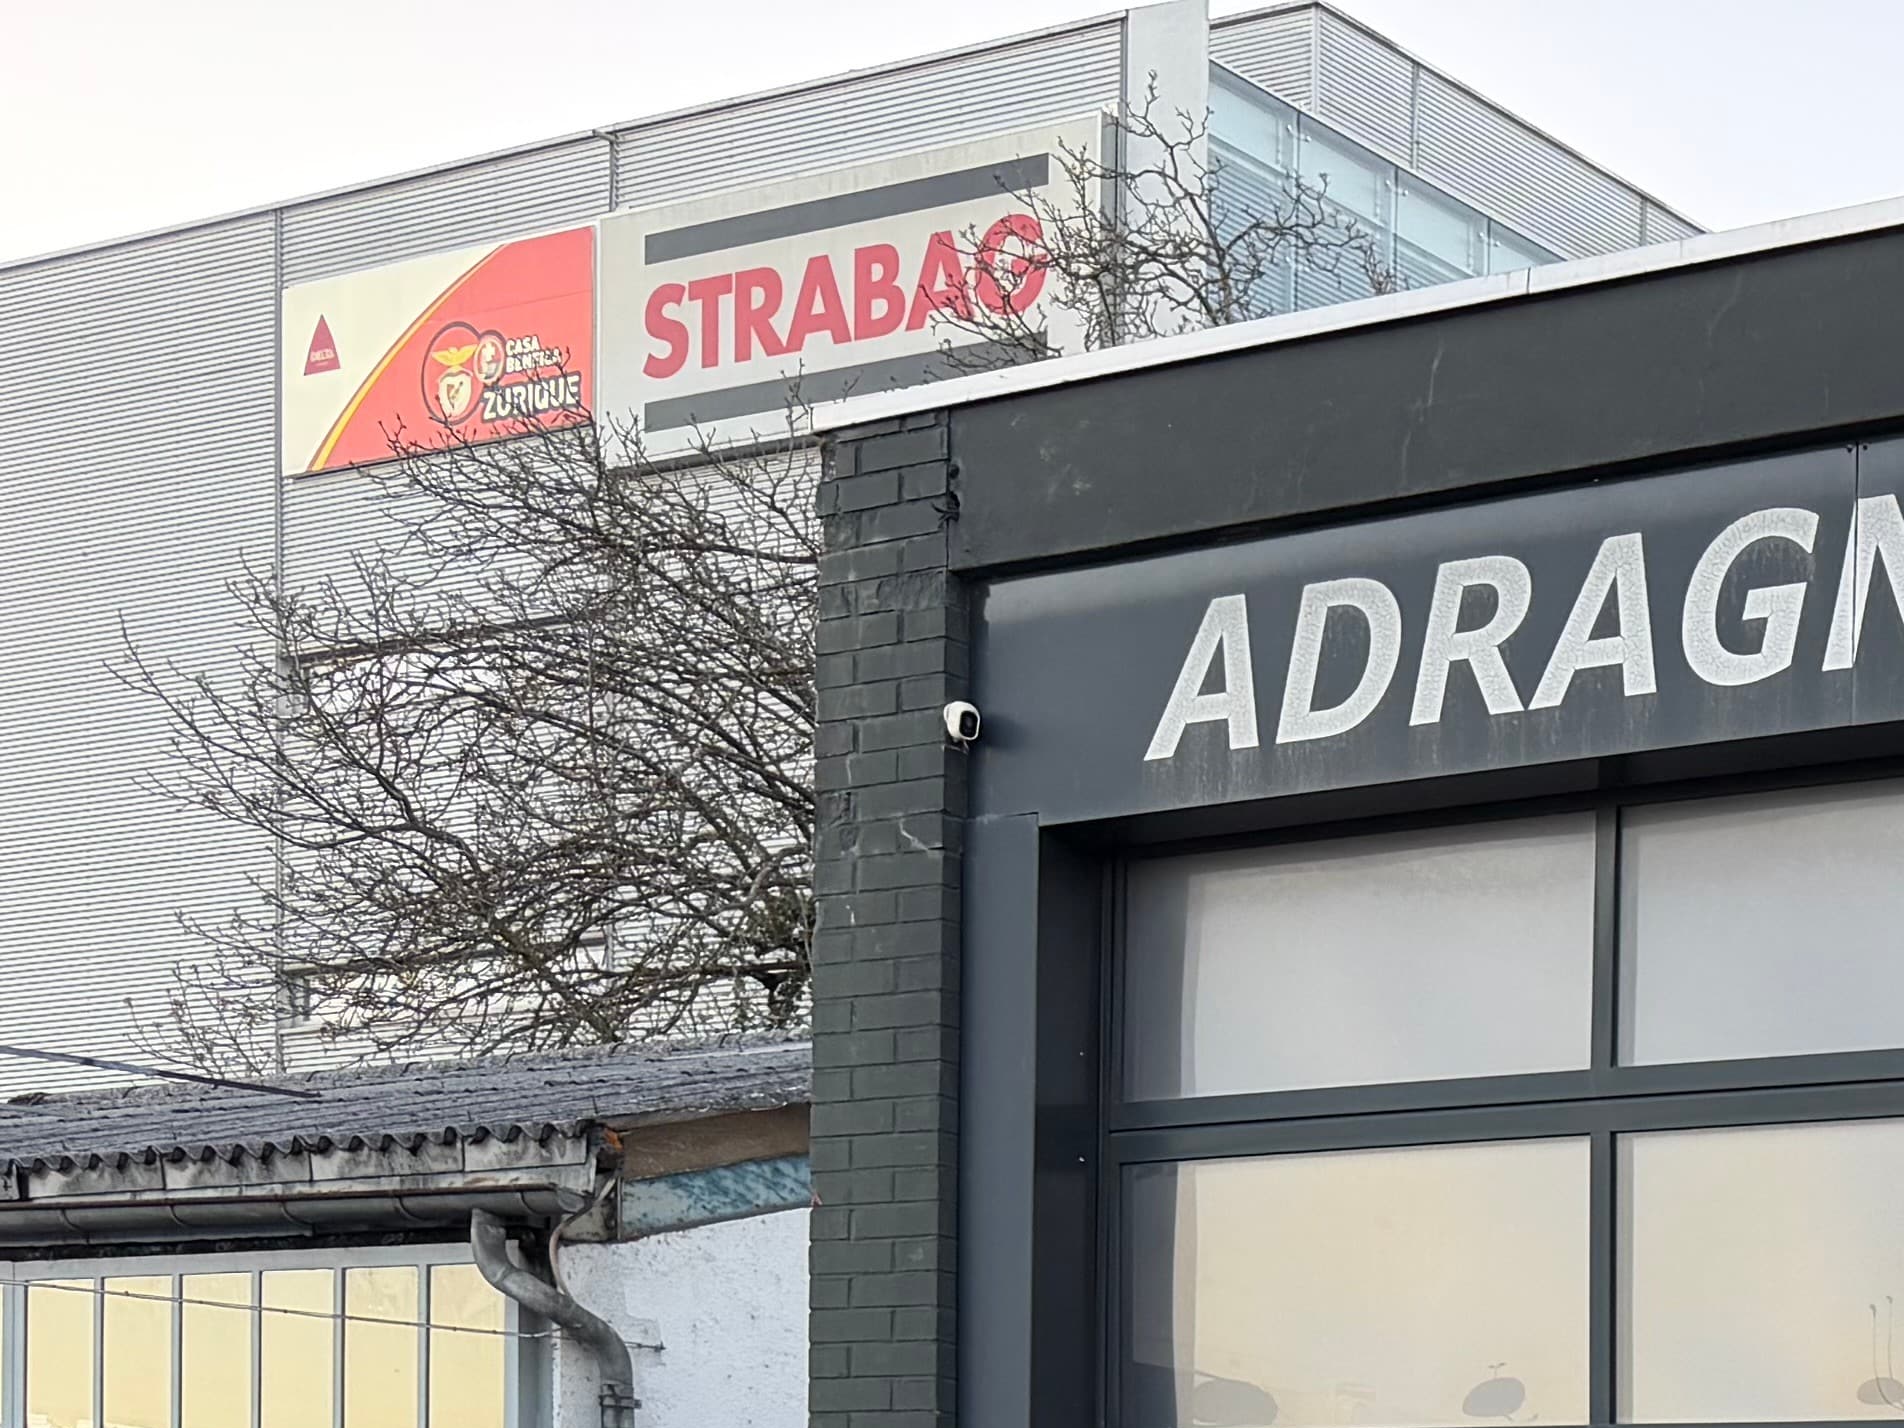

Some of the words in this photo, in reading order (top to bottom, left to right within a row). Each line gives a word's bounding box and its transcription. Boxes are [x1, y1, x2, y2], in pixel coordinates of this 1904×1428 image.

[643, 214, 1049, 379] STRABAG
[506, 335, 541, 356] CASA
[482, 374, 581, 421] ZURIQUE
